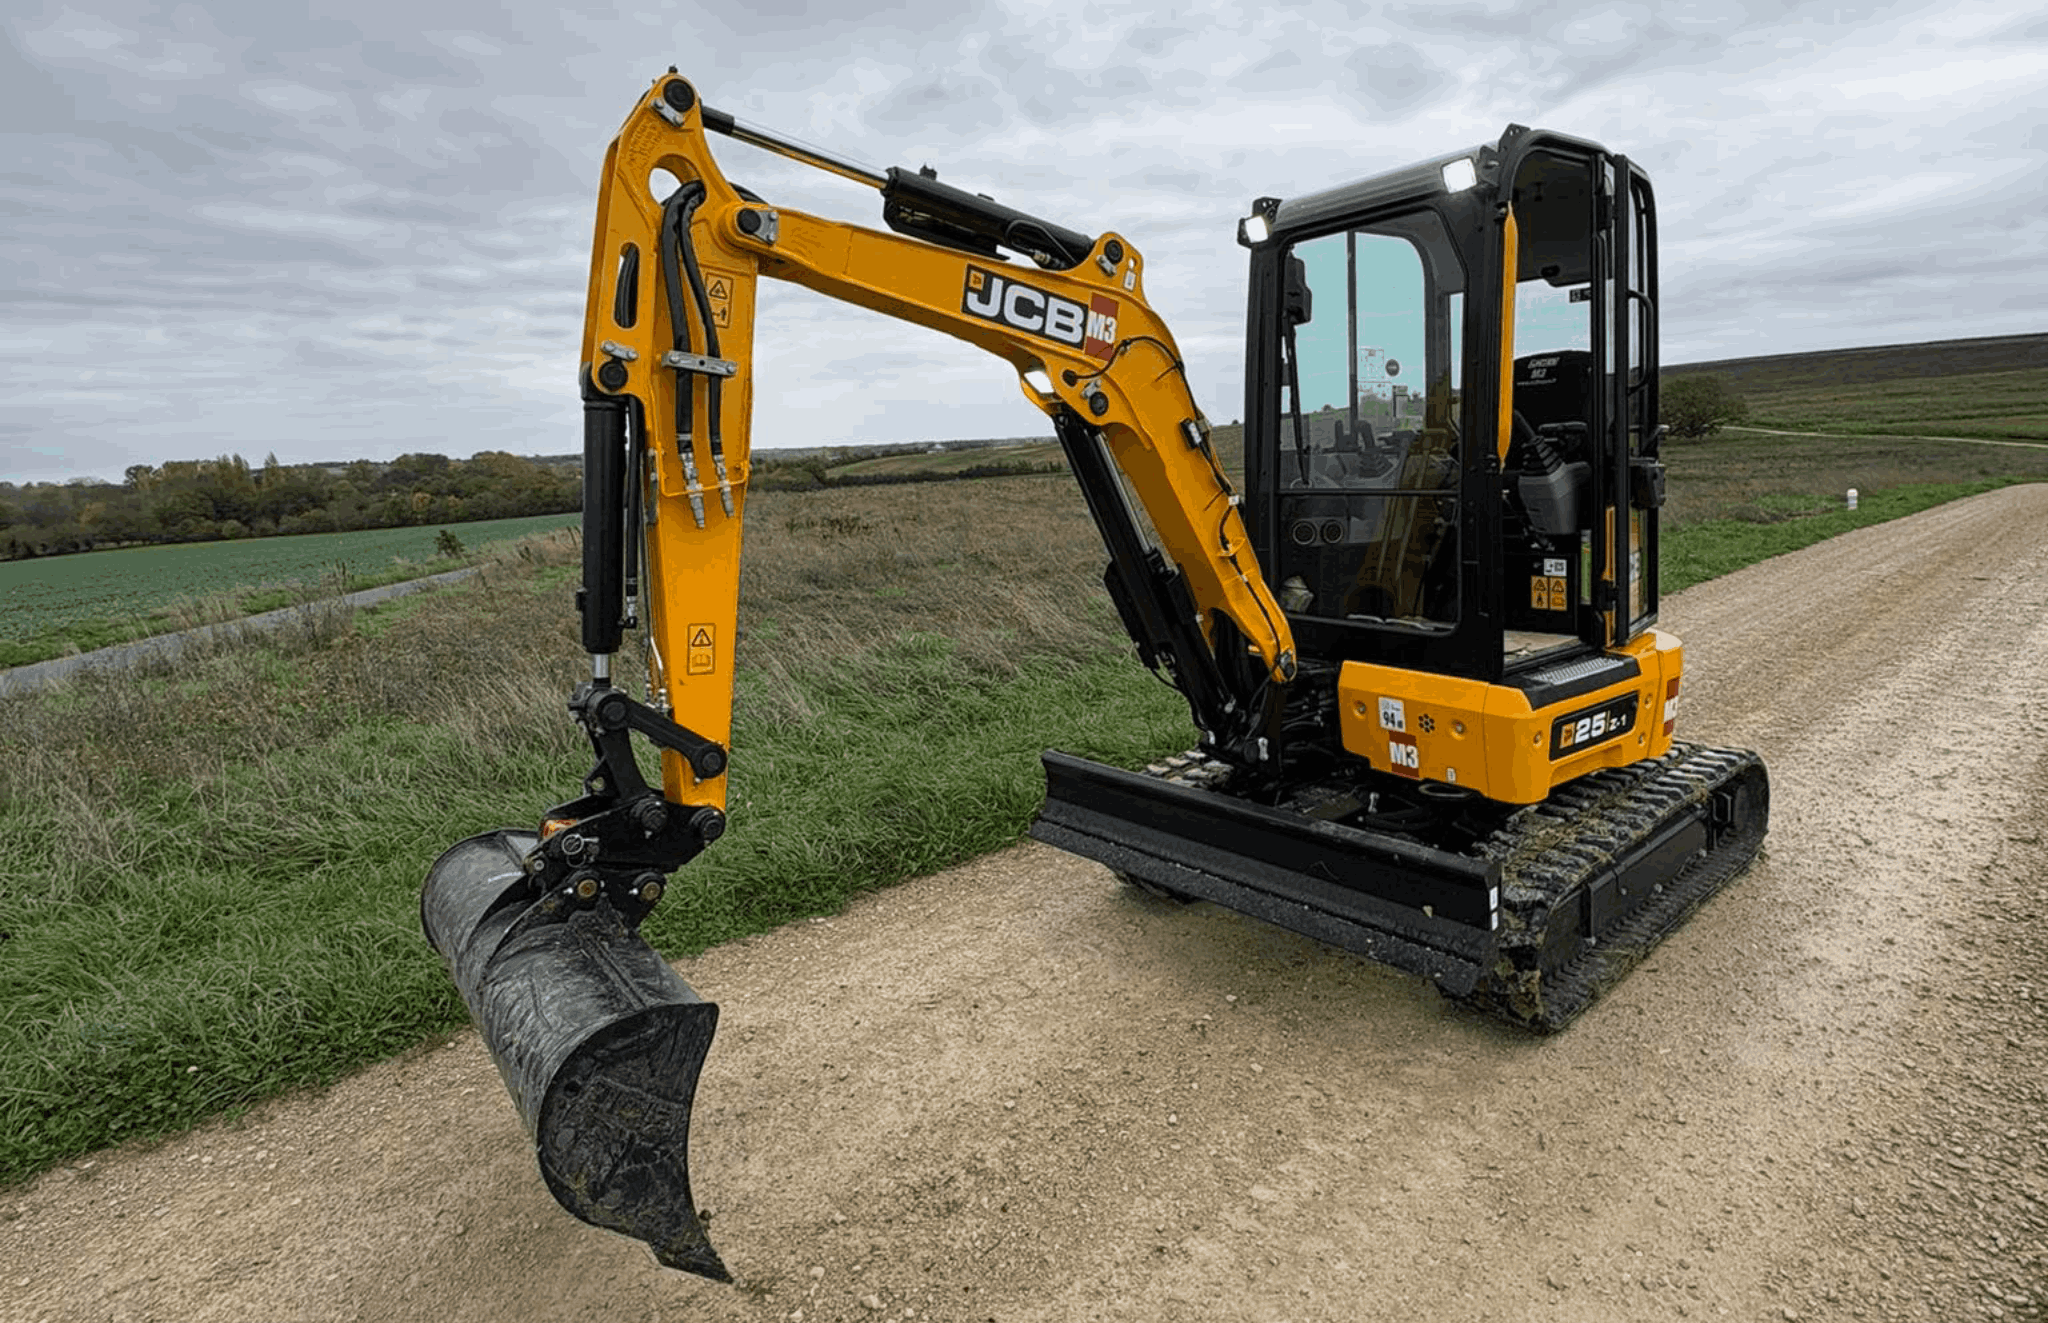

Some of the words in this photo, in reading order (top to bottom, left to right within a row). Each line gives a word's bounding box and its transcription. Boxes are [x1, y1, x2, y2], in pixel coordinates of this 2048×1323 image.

[967, 277, 1084, 343] JCB
[1087, 310, 1117, 344] M3
[1575, 711, 1607, 744] 25
[1389, 741, 1419, 769] M3
